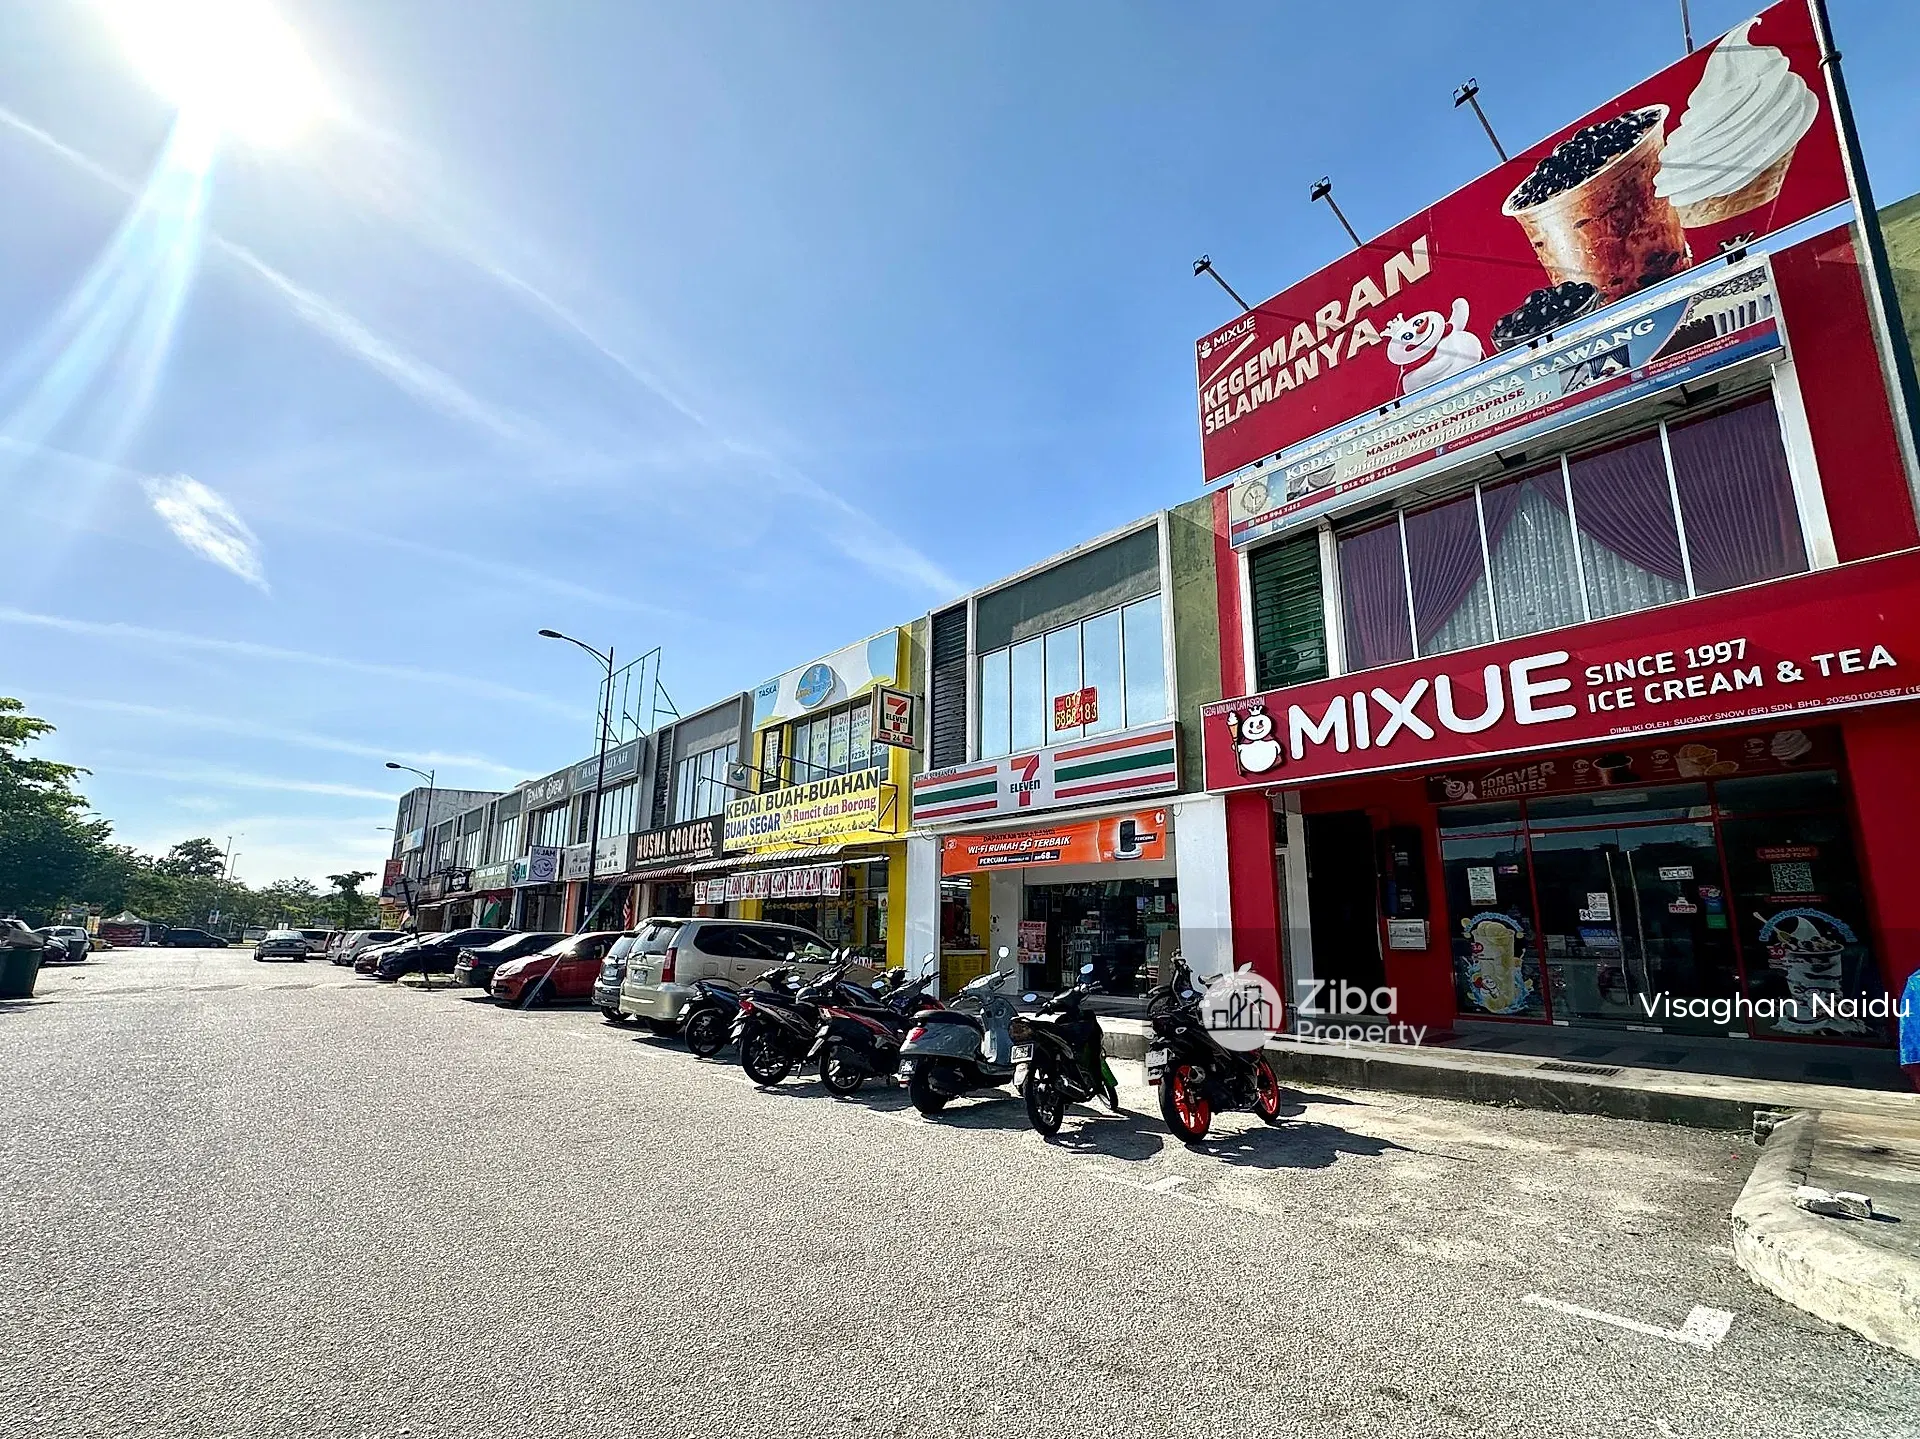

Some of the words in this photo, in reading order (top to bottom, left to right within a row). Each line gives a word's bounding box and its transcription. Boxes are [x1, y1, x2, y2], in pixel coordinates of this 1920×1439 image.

[1203, 234, 1431, 413] KEGEMARAN
[1213, 315, 1256, 347] MIXUE
[1205, 318, 1382, 435] SELAMANYA
[1284, 447, 1343, 480] KEDAI
[1346, 421, 1409, 456] JAHIT
[1412, 373, 1525, 428] SAUJANA
[1529, 318, 1655, 381] RAWANG
[1366, 418, 1439, 458] MASMAWATI
[1442, 387, 1526, 427] ENTERPRISE
[1586, 651, 1676, 687] SINCE
[1684, 638, 1747, 669] 1997
[1587, 686, 1636, 713] ICE
[1644, 665, 1764, 704] CREAM
[1776, 660, 1804, 684] &
[1811, 644, 1897, 677] TEA
[1288, 650, 1577, 760] MIXUE
[1609, 724, 1643, 735] DIMILIKI
[1644, 720, 1672, 730] OLEH:
[1673, 713, 1713, 726] SUGARY
[1714, 709, 1745, 720] SNOW
[1747, 705, 1769, 716] (SR)
[1770, 702, 1796, 713] SDN.
[1797, 698, 1825, 709] BHD.
[1826, 687, 1902, 706] 202501003587
[725, 796, 761, 820] KEDAI
[765, 768, 879, 810] BUAH-BUAHAN
[1481, 761, 1557, 790] FOREVER
[1482, 777, 1548, 799] FAVORITES
[725, 816, 748, 840] BUAH
[749, 812, 781, 835] SEGAR
[793, 807, 821, 823] Runcit
[823, 802, 839, 816] dan
[841, 795, 877, 815] Borong
[636, 830, 666, 859] HUSNA
[669, 821, 713, 853] COOKIES
[967, 843, 987, 854] WI-FI
[988, 841, 1018, 853] RUMAH
[1019, 837, 1032, 851] 5G
[1034, 836, 1071, 848] TERBAIK
[979, 856, 1008, 865] PERCUMA
